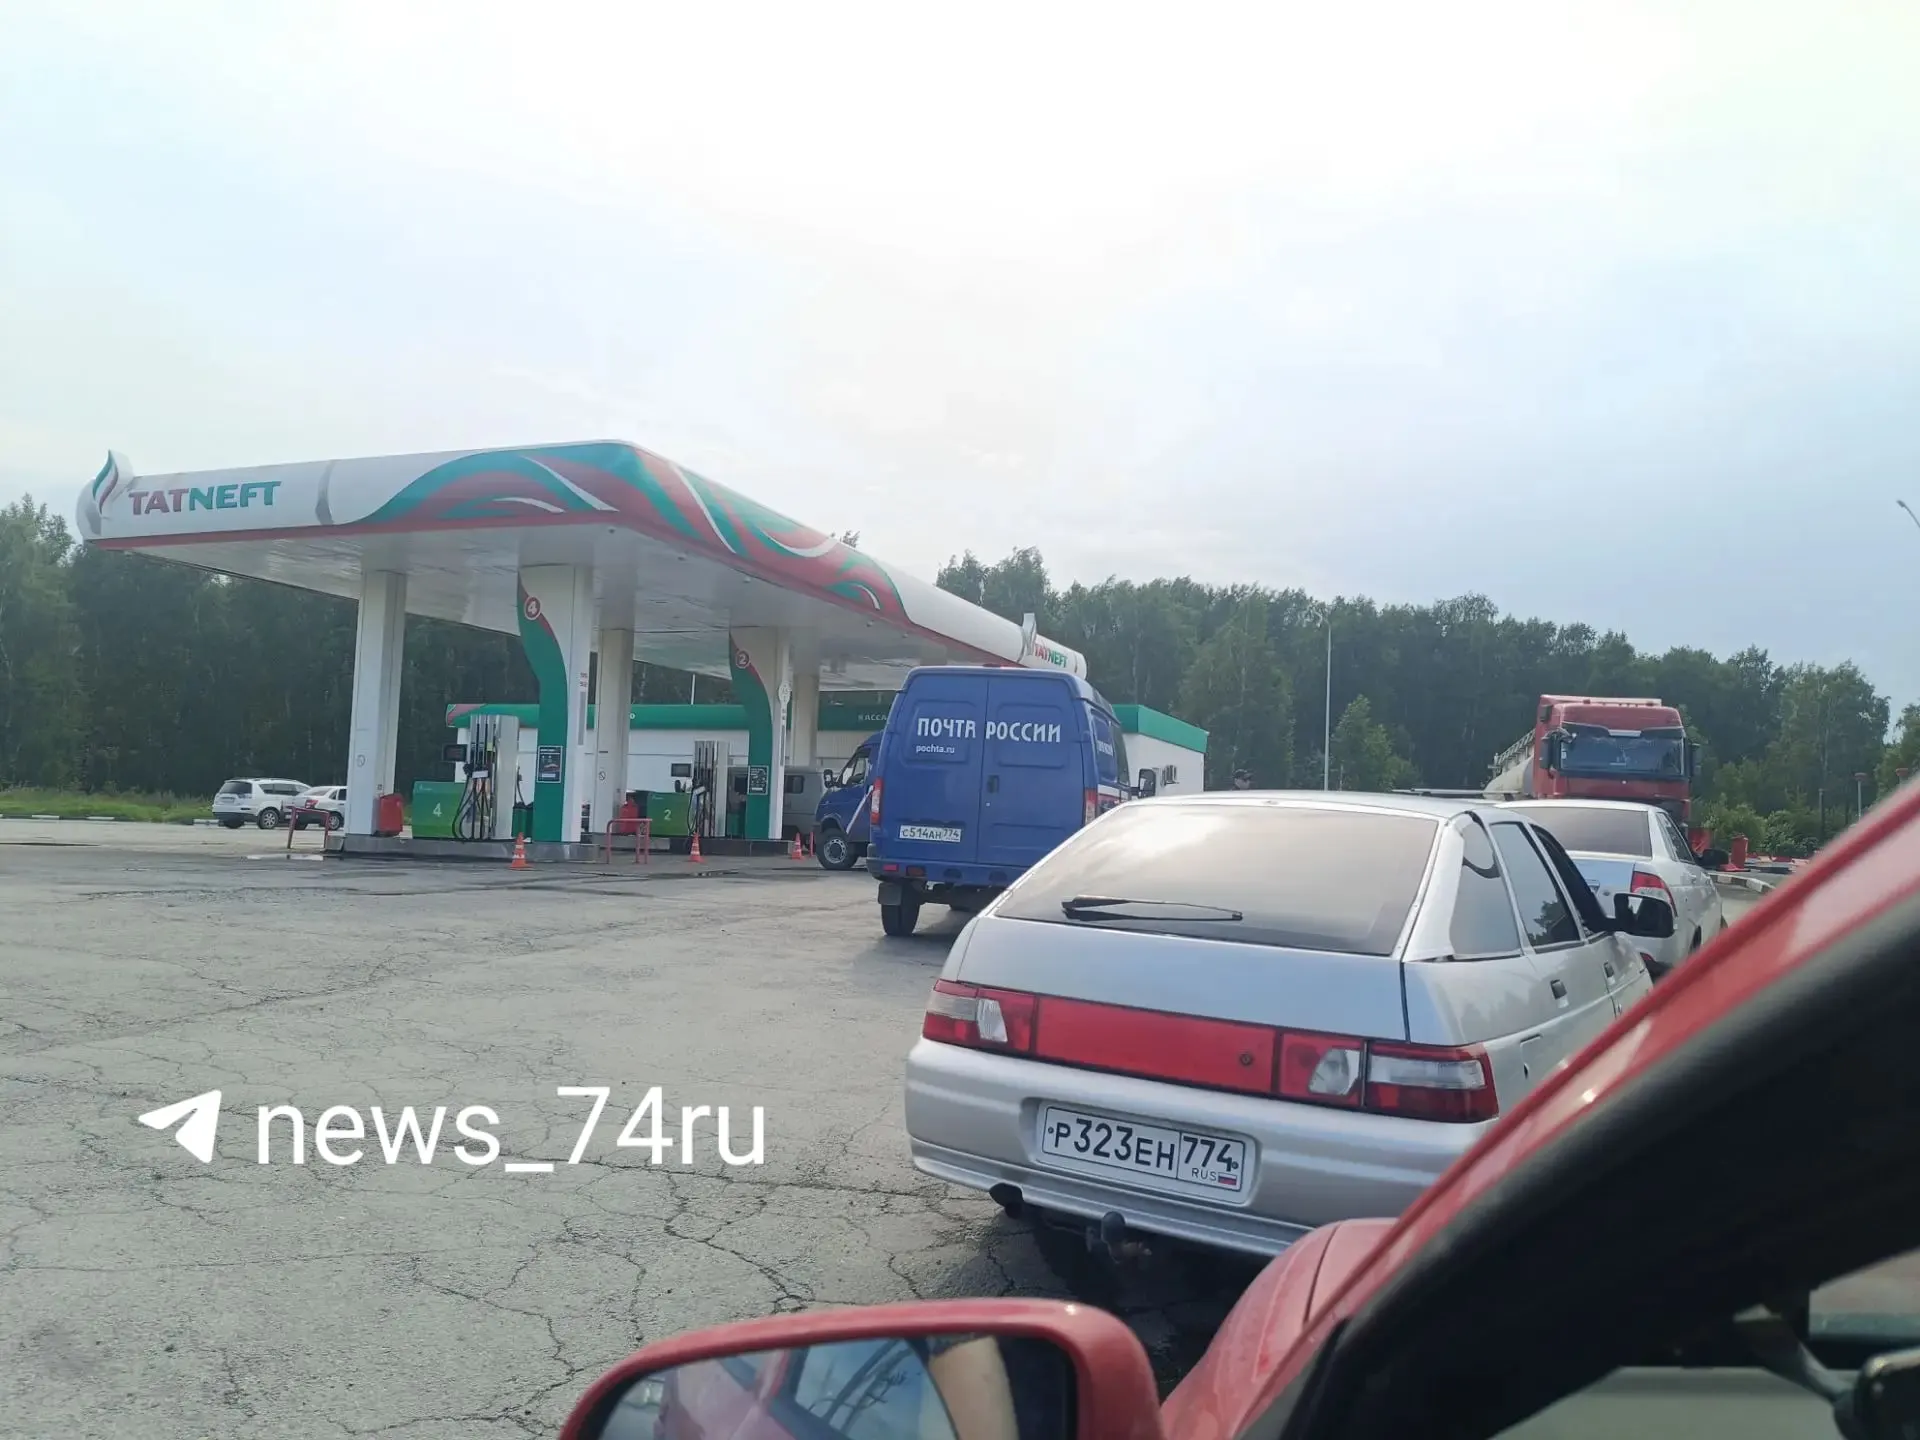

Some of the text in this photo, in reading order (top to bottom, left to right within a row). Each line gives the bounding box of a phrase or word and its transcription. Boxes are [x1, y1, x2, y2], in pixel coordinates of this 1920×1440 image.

[128, 481, 282, 515] TATNEFT
[527, 601, 538, 615] 4
[738, 654, 747, 665] 2
[1034, 643, 1068, 668] TATNEFT
[917, 718, 1061, 743] ПОЧТА РОССИИ
[916, 744, 955, 754] pochta.ru
[432, 803, 443, 817] 4
[664, 809, 672, 821] 2
[1191, 1167, 1217, 1182] RUS
